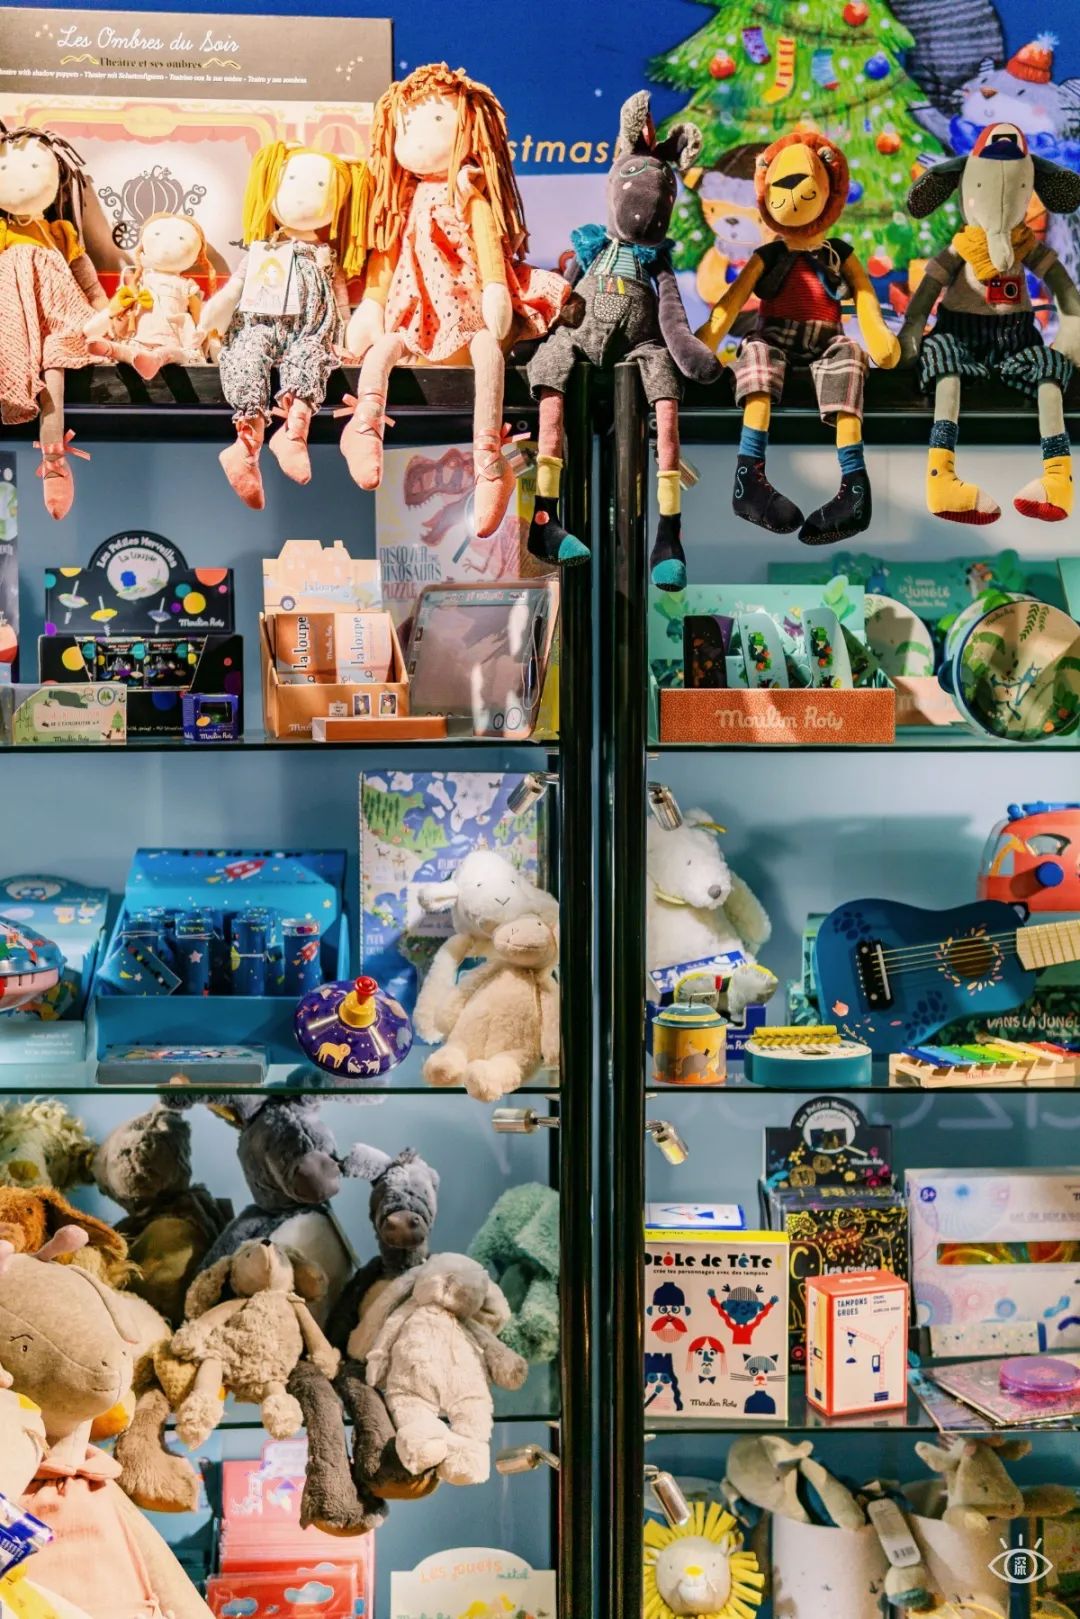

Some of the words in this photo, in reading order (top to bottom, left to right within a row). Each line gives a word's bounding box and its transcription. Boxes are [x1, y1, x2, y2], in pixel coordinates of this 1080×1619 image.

[57, 25, 92, 48] Les
[97, 26, 163, 50] Ombres
[169, 32, 194, 51] du
[199, 30, 240, 52] Soir
[166, 59, 202, 69] ombres
[293, 616, 310, 653] loupe
[715, 707, 798, 730] Moulin
[803, 705, 844, 730] Roty
[1022, 1015, 1036, 1029] LA
[701, 1253, 722, 1268] de
[837, 1297, 868, 1307] TAMPONS
[690, 1397, 721, 1407] Moulin
